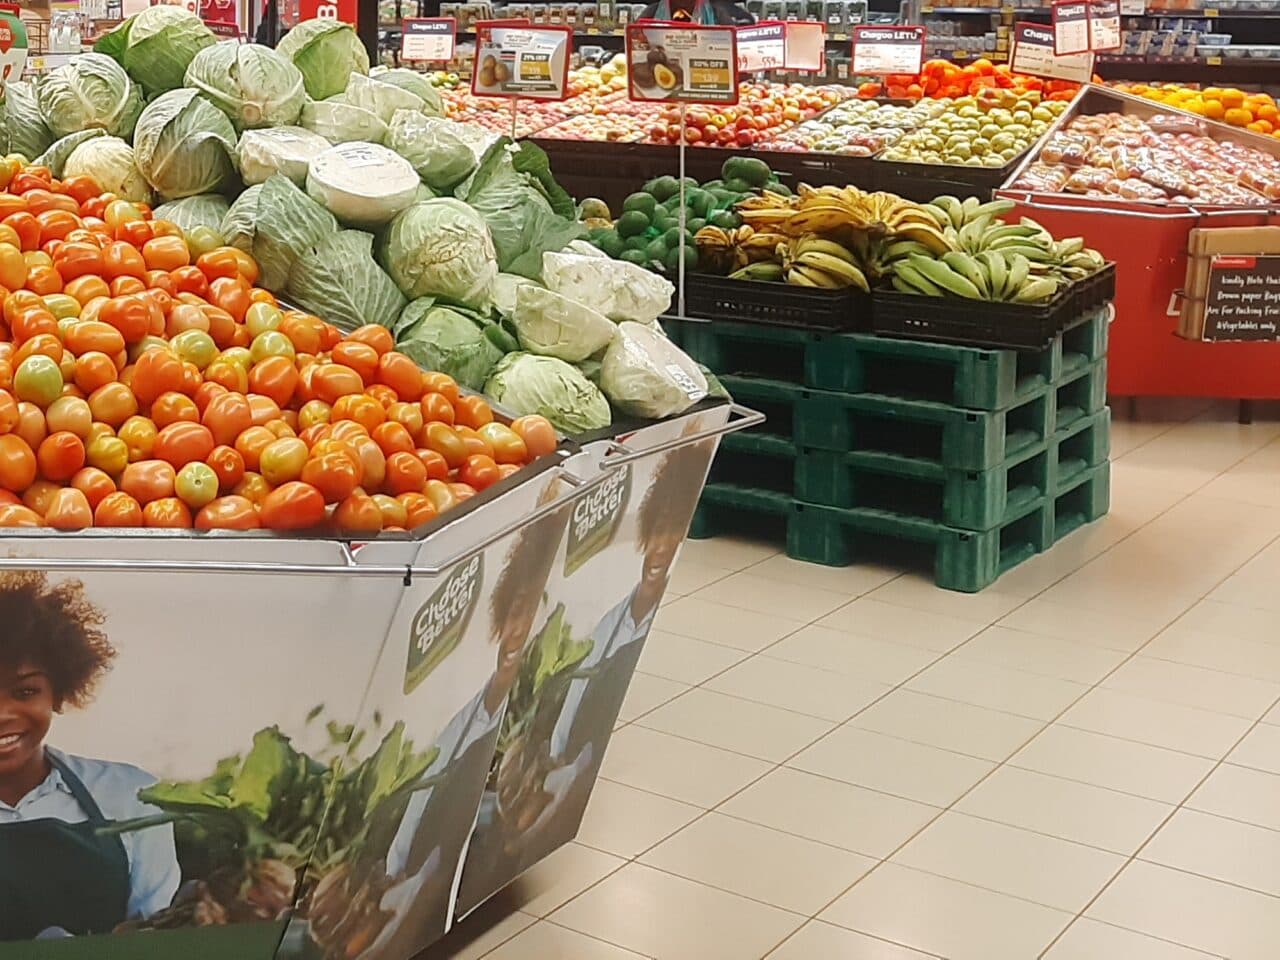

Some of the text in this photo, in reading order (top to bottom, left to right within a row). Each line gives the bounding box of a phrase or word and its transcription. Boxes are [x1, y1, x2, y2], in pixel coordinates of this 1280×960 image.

[894, 31, 917, 40] LETU
[1264, 305, 1280, 316] Fru
[573, 464, 628, 523] Choose
[575, 485, 624, 542] Better
[415, 555, 480, 637] Choose
[417, 580, 476, 655] Better
